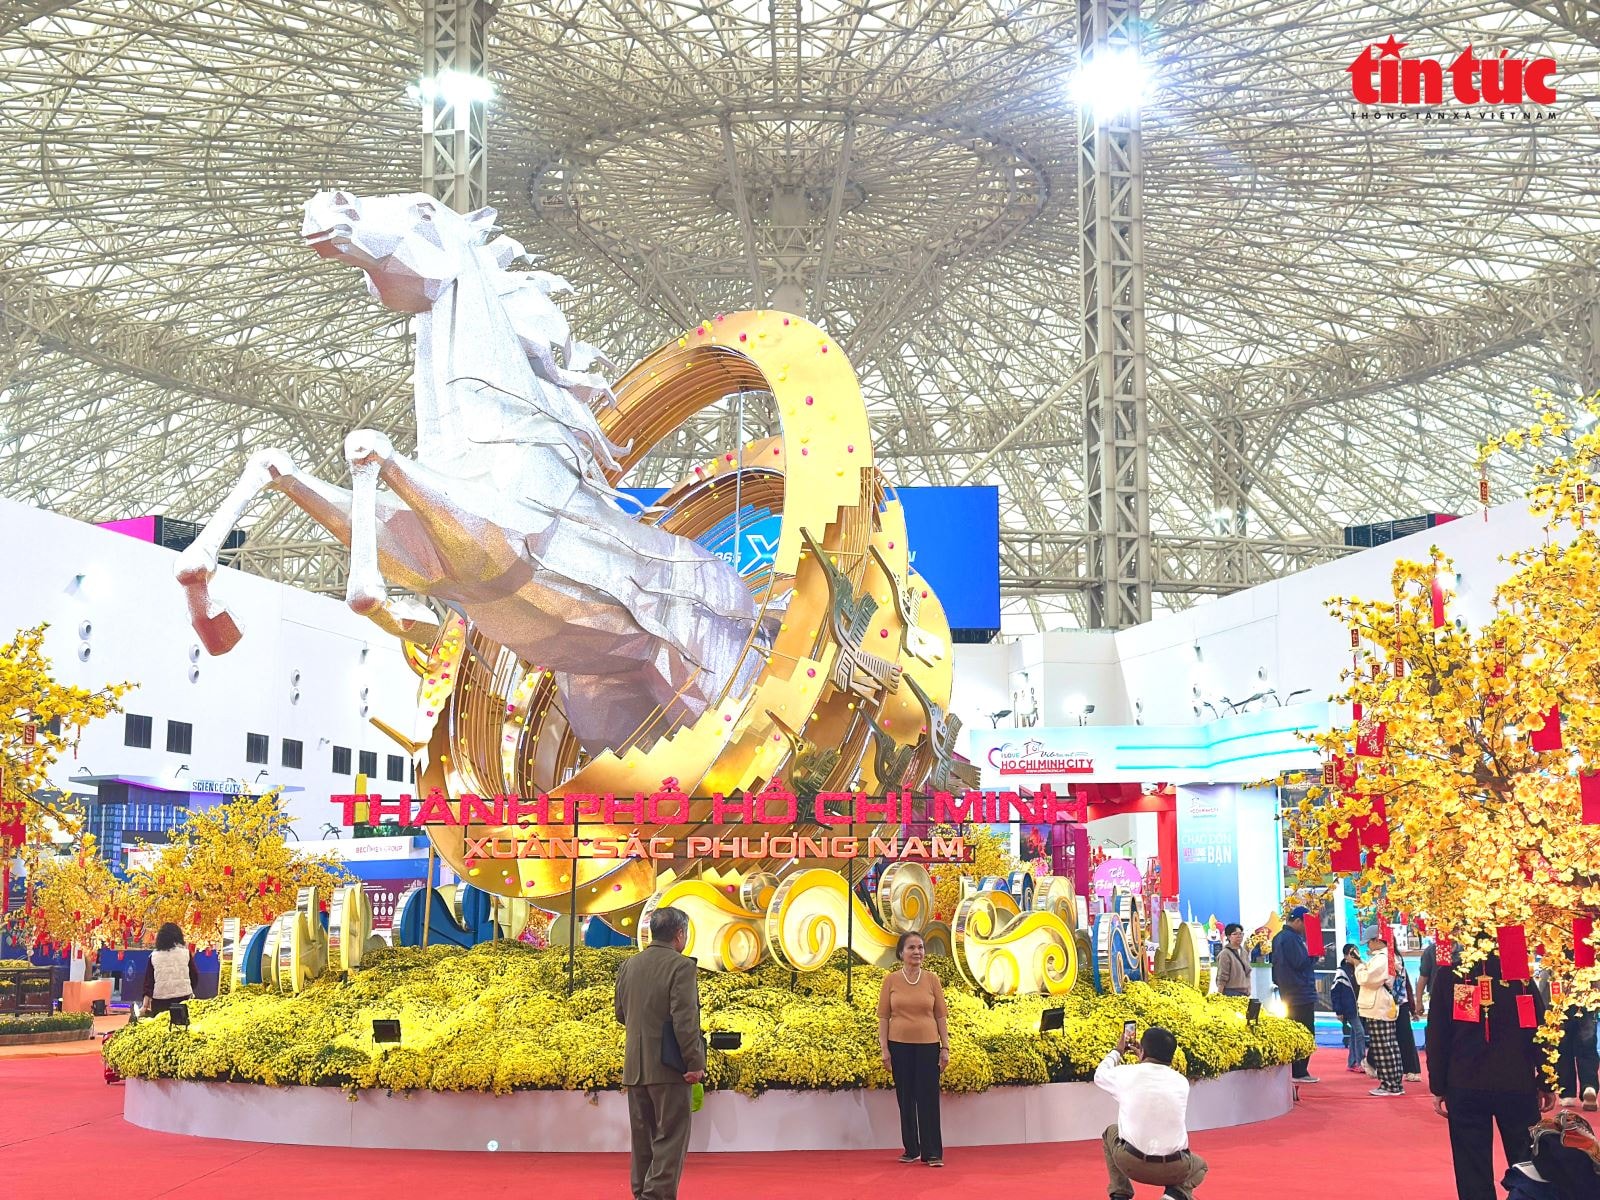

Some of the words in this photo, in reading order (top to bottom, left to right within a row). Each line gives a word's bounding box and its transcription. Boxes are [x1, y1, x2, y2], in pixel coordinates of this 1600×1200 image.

[1018, 759, 1036, 770] CHI
[1037, 759, 1065, 770] MINH
[1066, 758, 1094, 769] CITY
[192, 781, 224, 792] SCIENCE
[330, 786, 550, 826] THÀNH
[563, 776, 690, 825] PHỐ
[712, 777, 798, 825] HỒ
[815, 783, 913, 825] CHÍ
[934, 790, 1088, 825] MINH
[464, 831, 579, 860] XUÂN
[592, 828, 675, 859] SẮC
[687, 831, 858, 859] PHƯƠNG
[868, 836, 964, 859] NAM
[1207, 845, 1232, 867] BẠN
